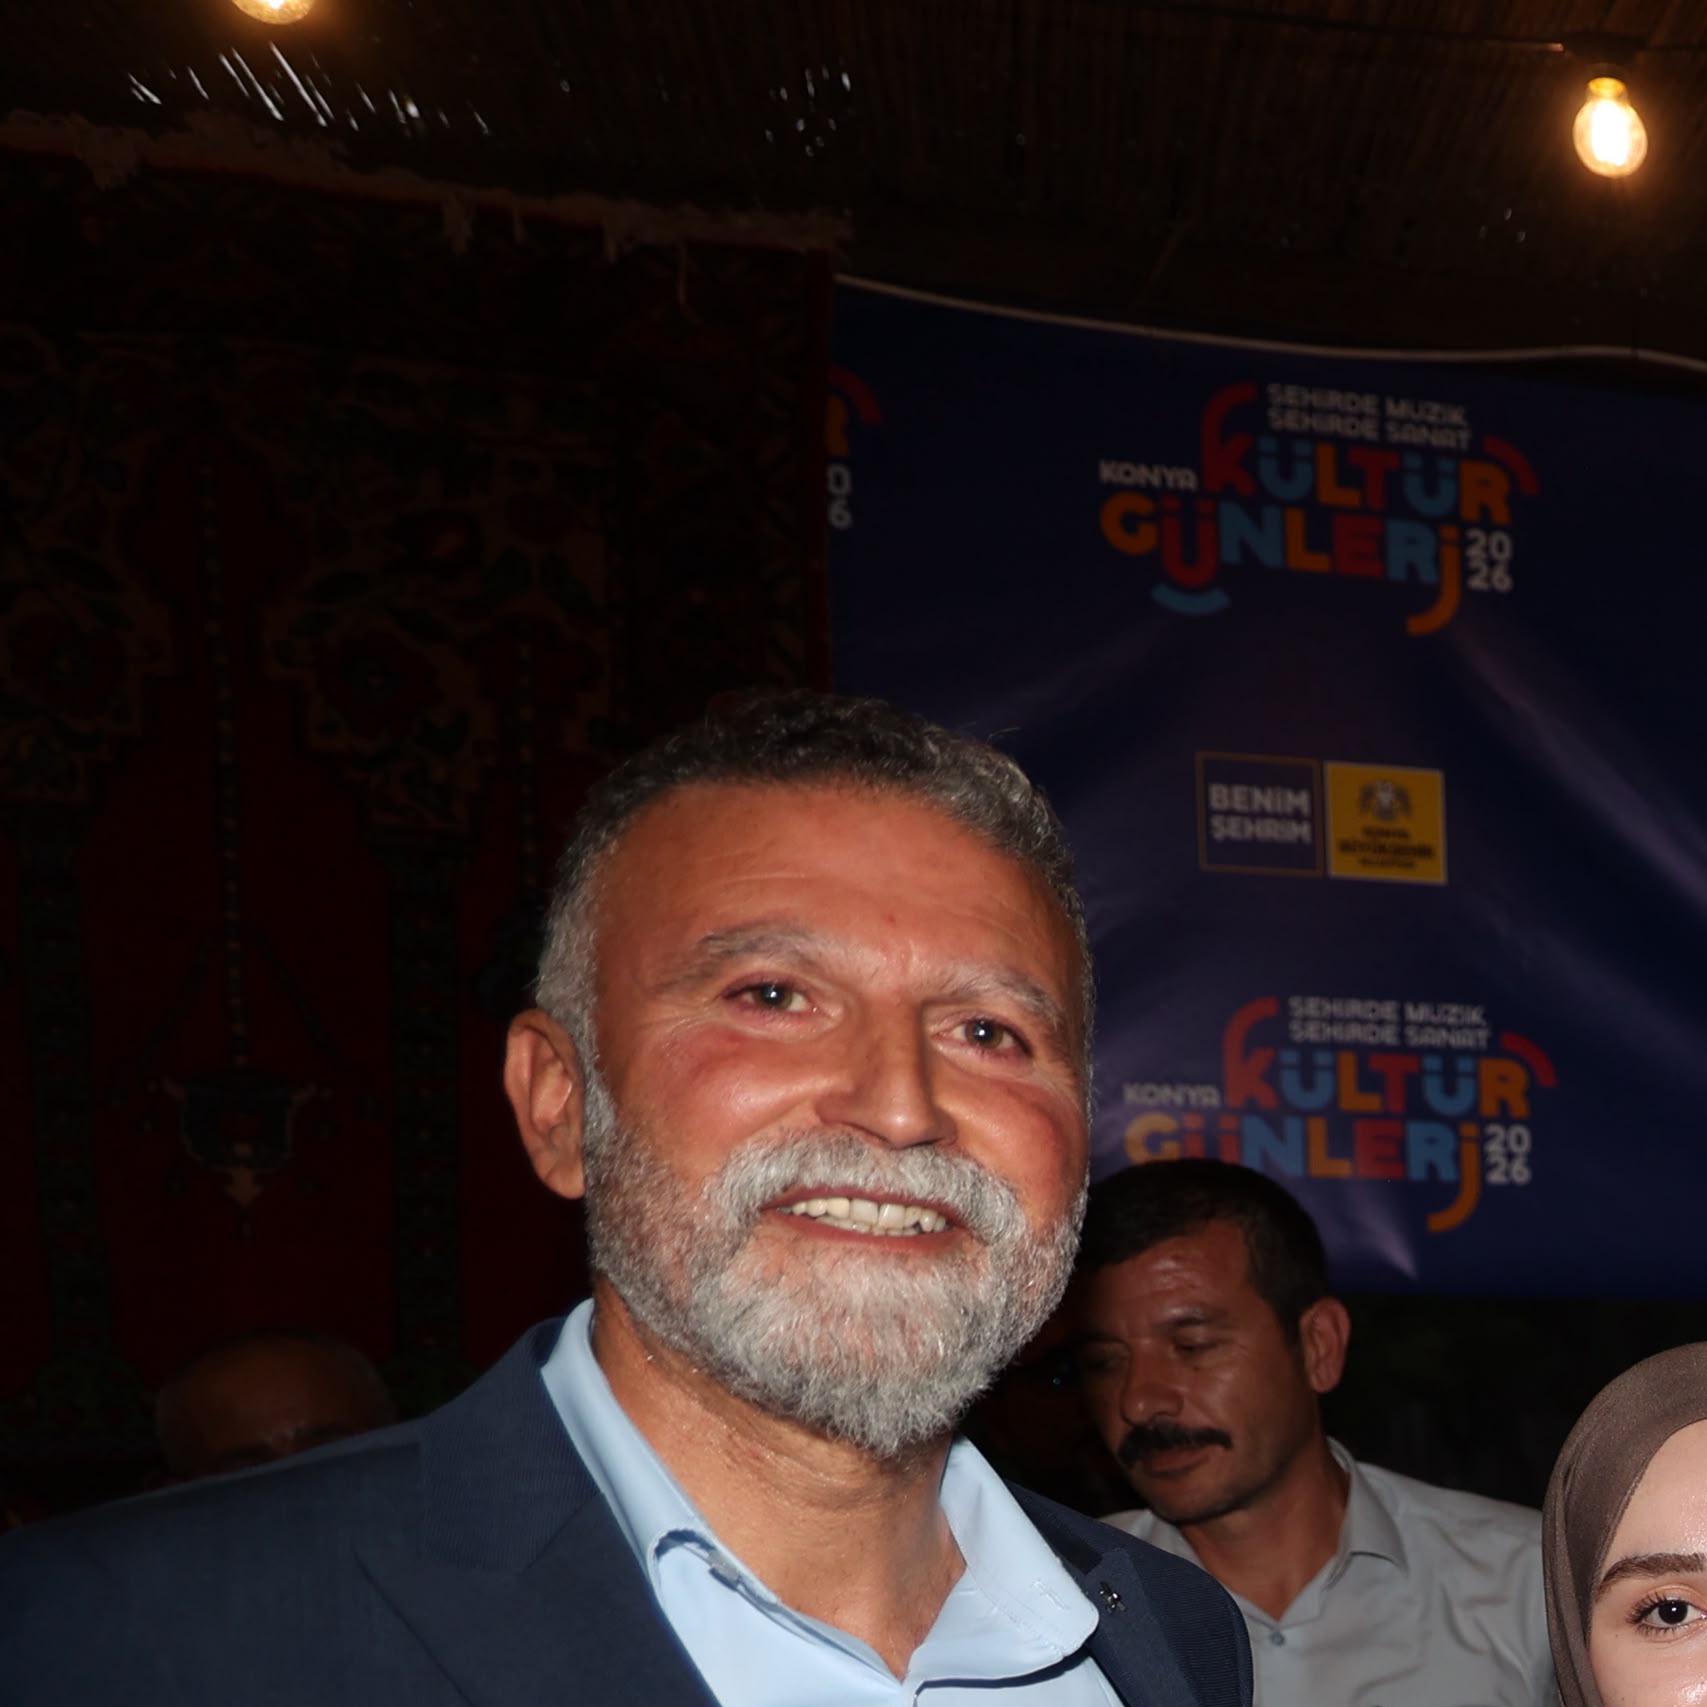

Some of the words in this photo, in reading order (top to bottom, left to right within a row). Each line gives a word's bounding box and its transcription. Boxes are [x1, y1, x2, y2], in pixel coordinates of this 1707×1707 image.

[1100, 460, 1199, 491] KONYA
[1203, 382, 1512, 526] KÜLTÜR
[1208, 783, 1311, 816] BENİM
[1210, 815, 1312, 844] ŞEHRİM
[1123, 1082, 1221, 1108] KONYA
[1223, 996, 1531, 1119] KÜLTÜR
